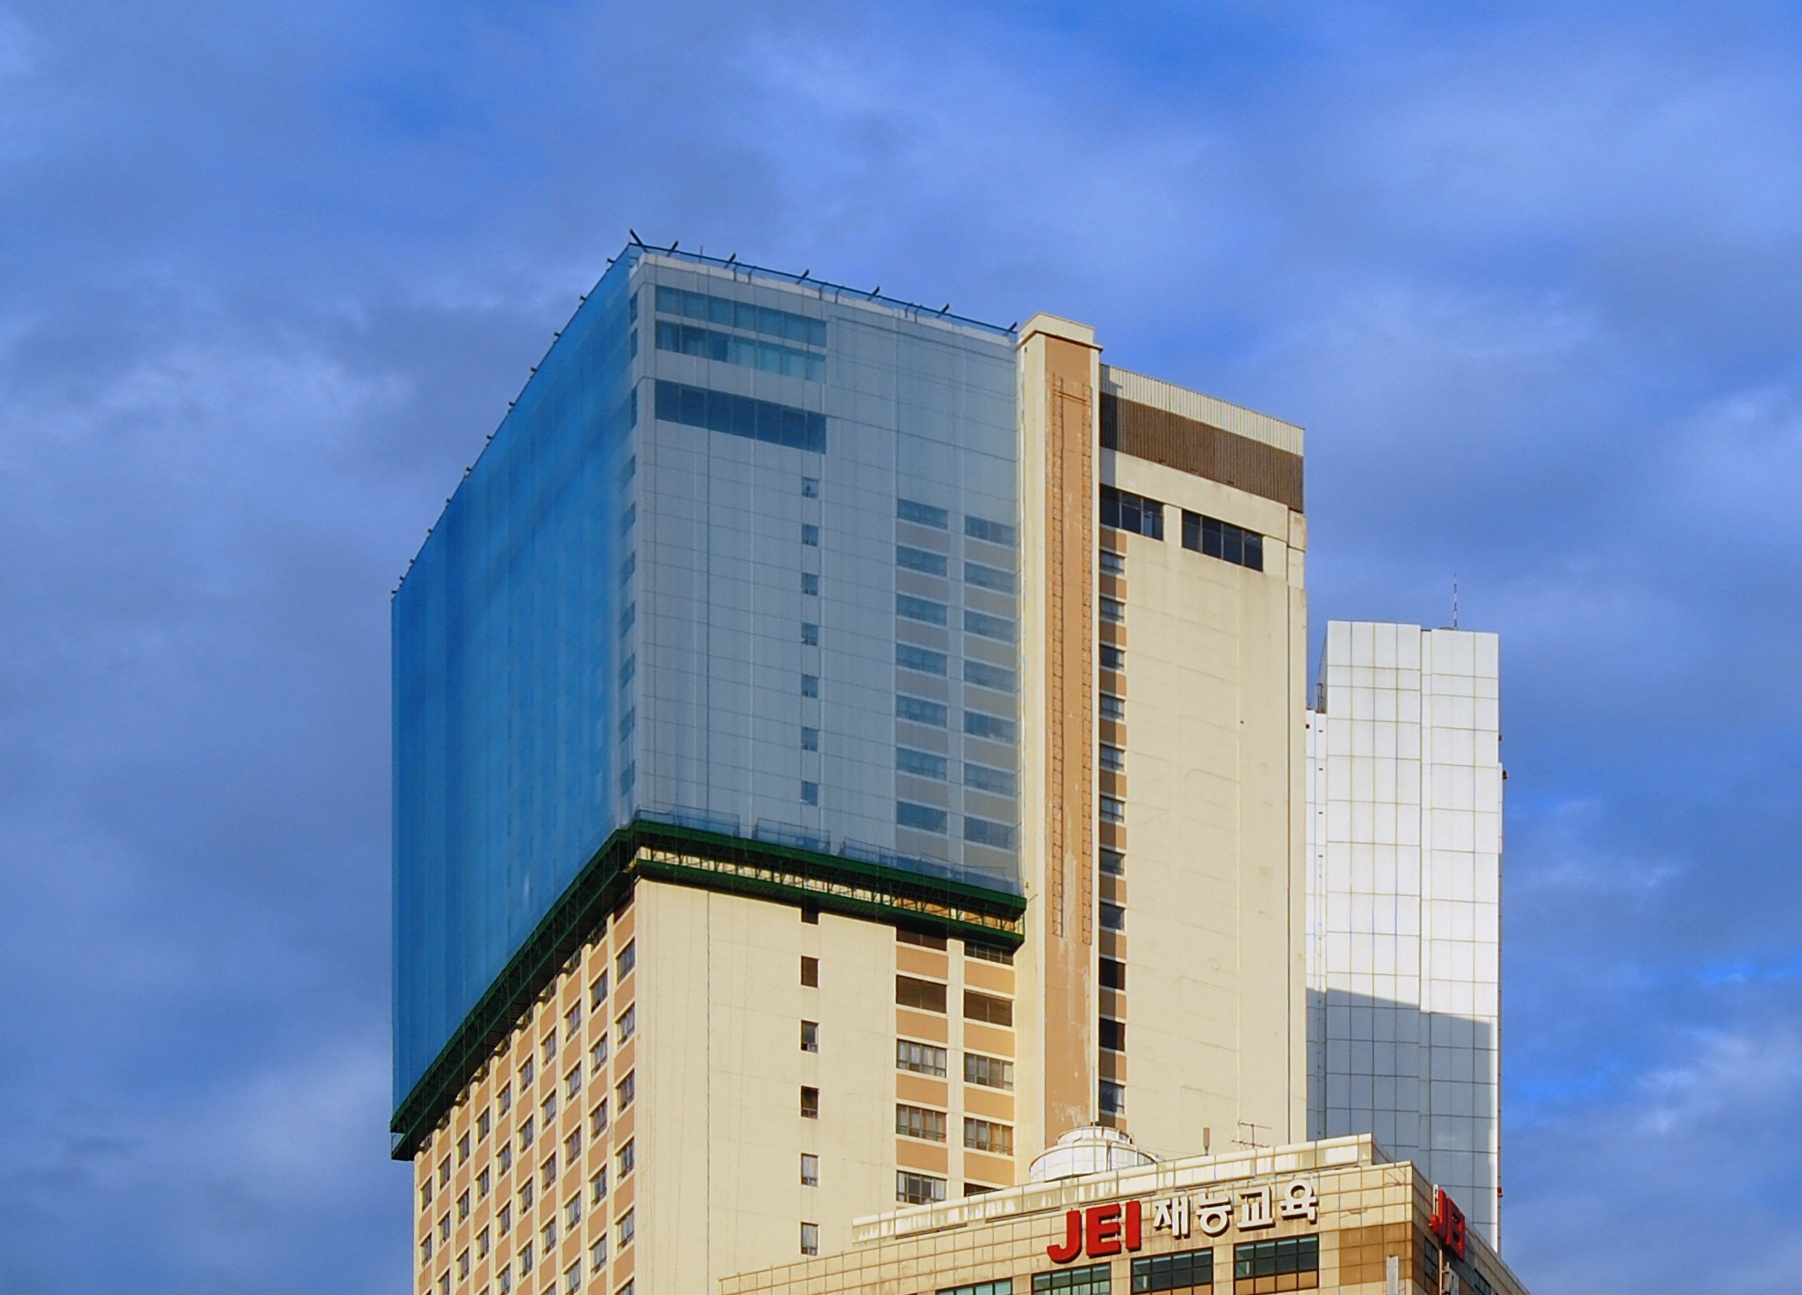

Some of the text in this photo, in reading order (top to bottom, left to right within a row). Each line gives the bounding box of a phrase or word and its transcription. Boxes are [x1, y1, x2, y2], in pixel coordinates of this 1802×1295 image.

[1046, 1179, 1322, 1263] JEI 재능교육
[1431, 1189, 1466, 1262] JEI
